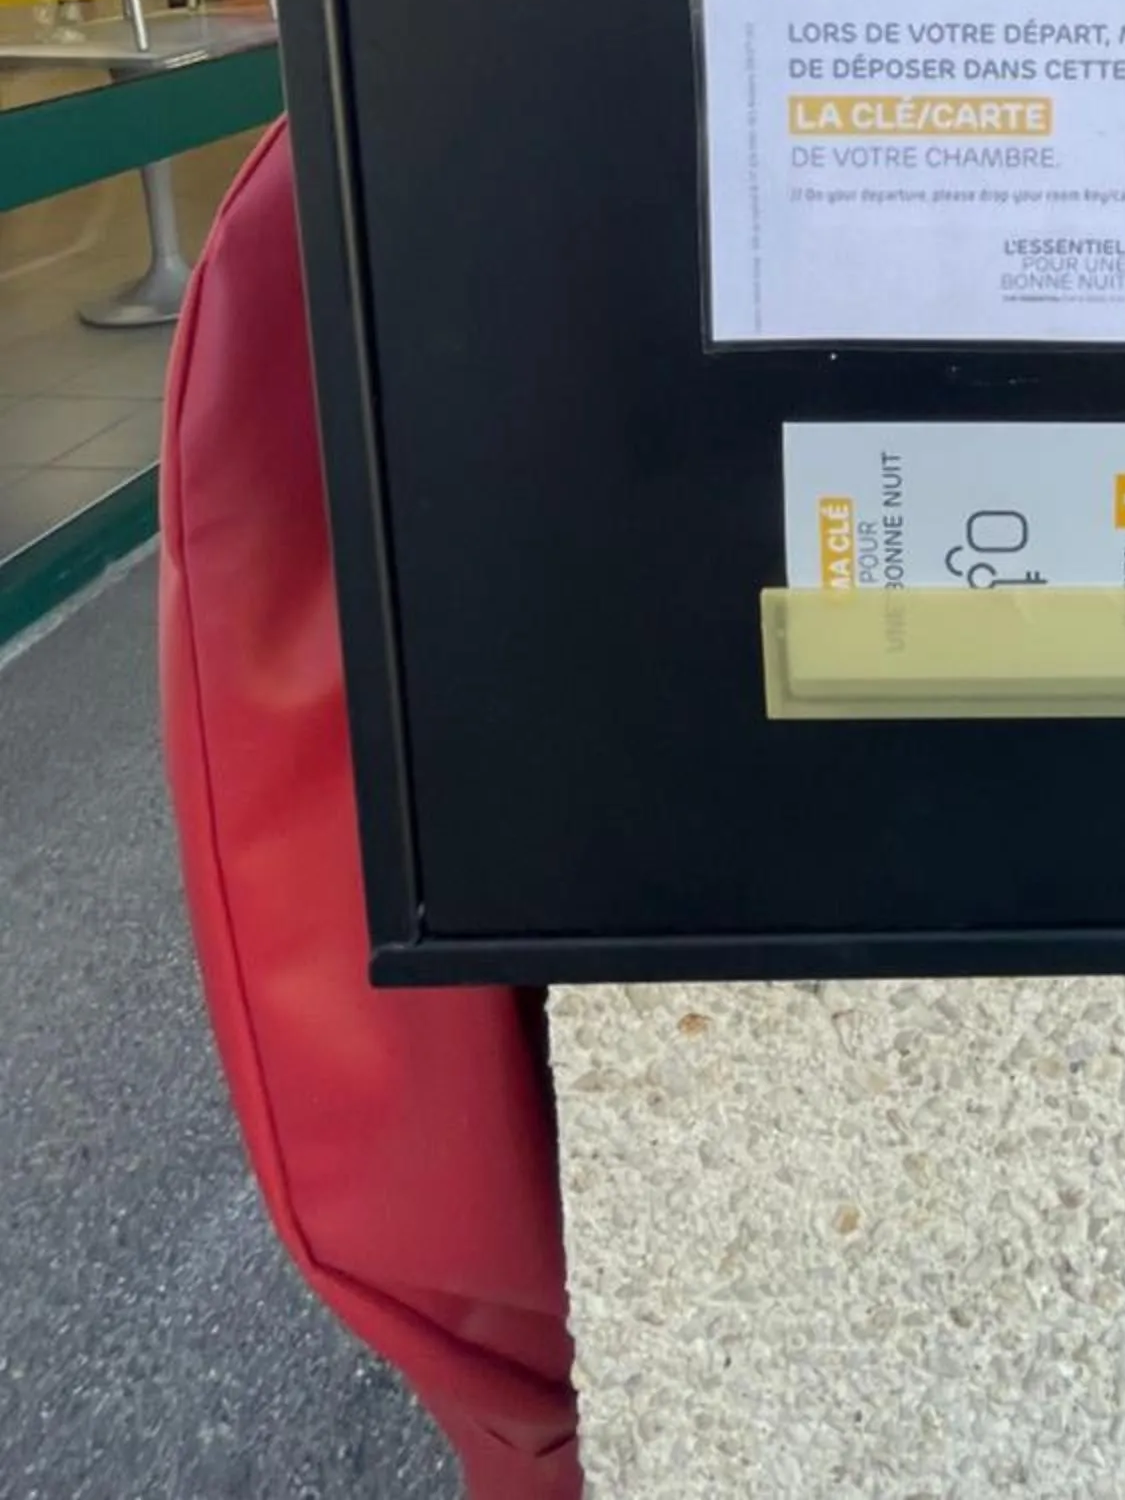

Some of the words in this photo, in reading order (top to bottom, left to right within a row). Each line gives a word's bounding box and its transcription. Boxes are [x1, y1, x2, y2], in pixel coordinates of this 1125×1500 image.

[788, 22, 857, 44] LORS
[865, 22, 900, 44] DE
[909, 23, 996, 44] VOTRE
[1004, 18, 1110, 47] DÉPART,
[788, 58, 823, 79] DE
[833, 53, 956, 80] DÉPOSER
[963, 59, 1037, 80] DANS
[795, 102, 844, 130] LA
[852, 96, 1048, 130] CLÉ/CARTE
[791, 147, 826, 168] DE
[833, 147, 917, 168] VOTRE
[925, 147, 1061, 169] CHAMBRE.
[1022, 256, 1078, 273] POUR
[1000, 273, 1073, 290] BONNE
[1078, 273, 1125, 290] NUIT
[881, 451, 904, 508] NUIT
[821, 503, 850, 553] CLÉ
[858, 521, 879, 584] POUR
